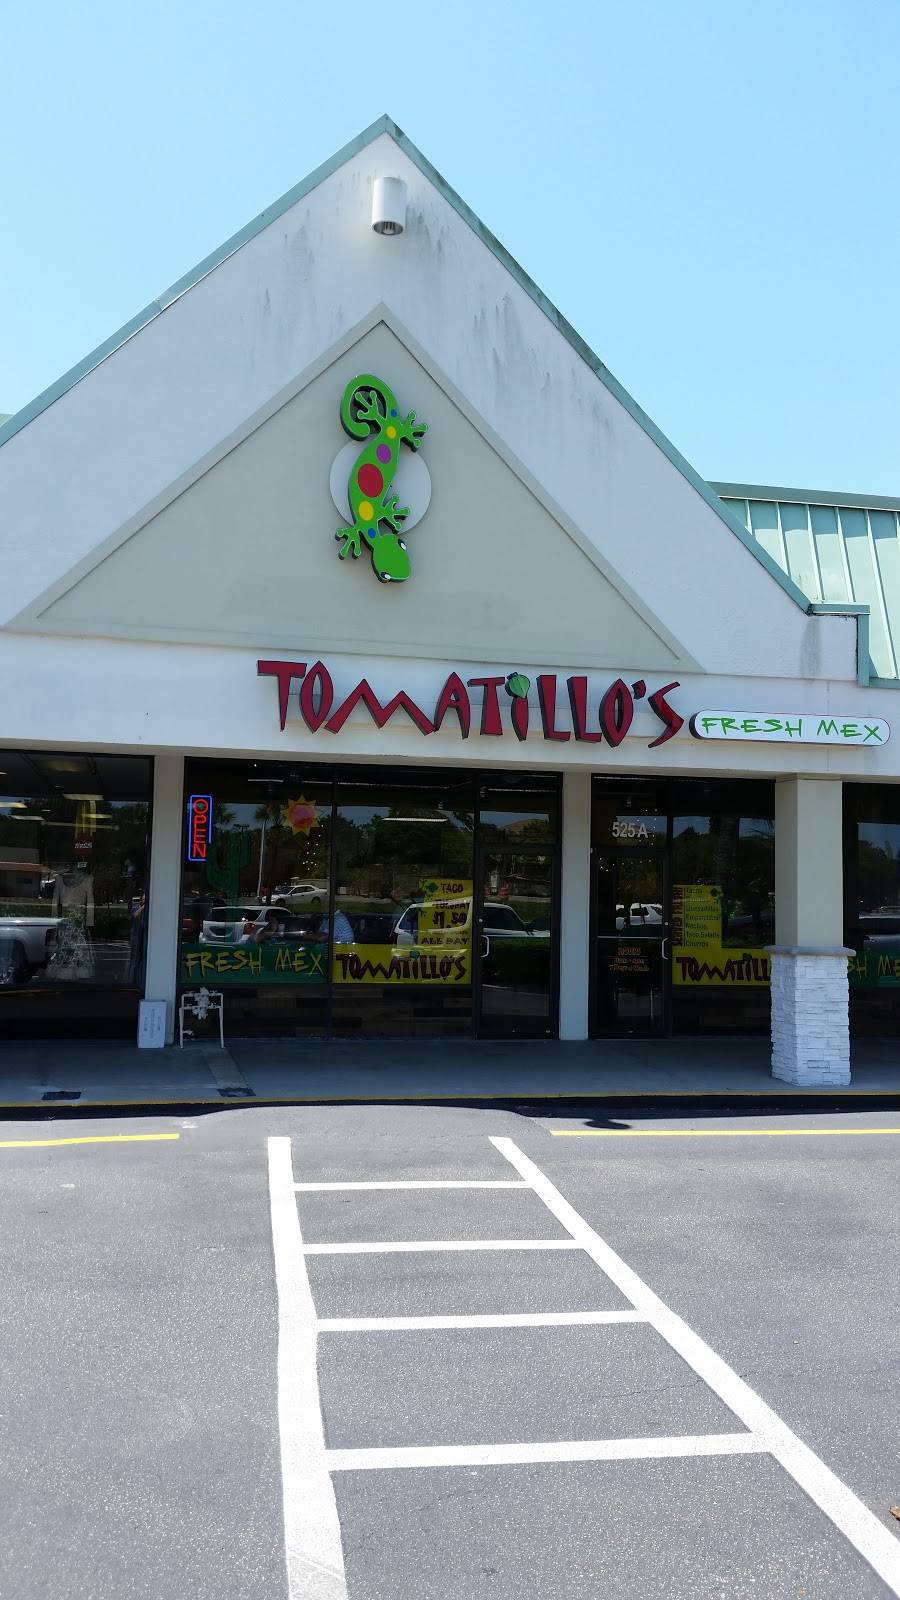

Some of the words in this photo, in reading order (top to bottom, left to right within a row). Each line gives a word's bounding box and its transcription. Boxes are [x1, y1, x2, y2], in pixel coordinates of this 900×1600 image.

[257, 660, 685, 748] TOMATILLO'S
[701, 717, 803, 738] FRESH
[817, 720, 885, 743] MEX
[192, 798, 209, 858] OPEN
[441, 883, 464, 893] TACO
[185, 949, 264, 977] FRESH
[275, 949, 323, 976] MEX
